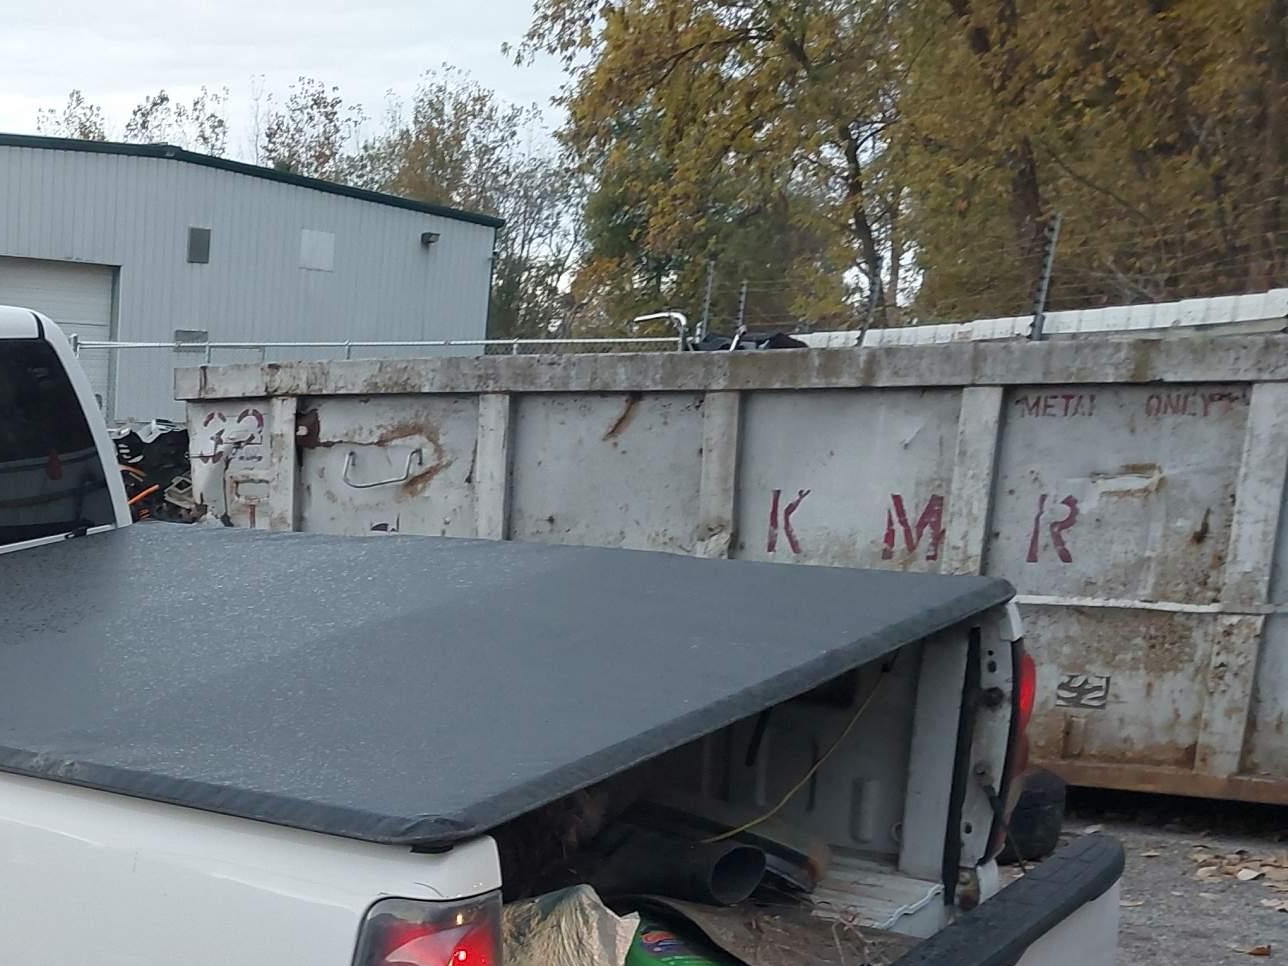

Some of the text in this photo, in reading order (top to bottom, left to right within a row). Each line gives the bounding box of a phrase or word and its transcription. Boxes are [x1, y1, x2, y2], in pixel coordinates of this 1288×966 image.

[766, 488, 1080, 563] K M R
